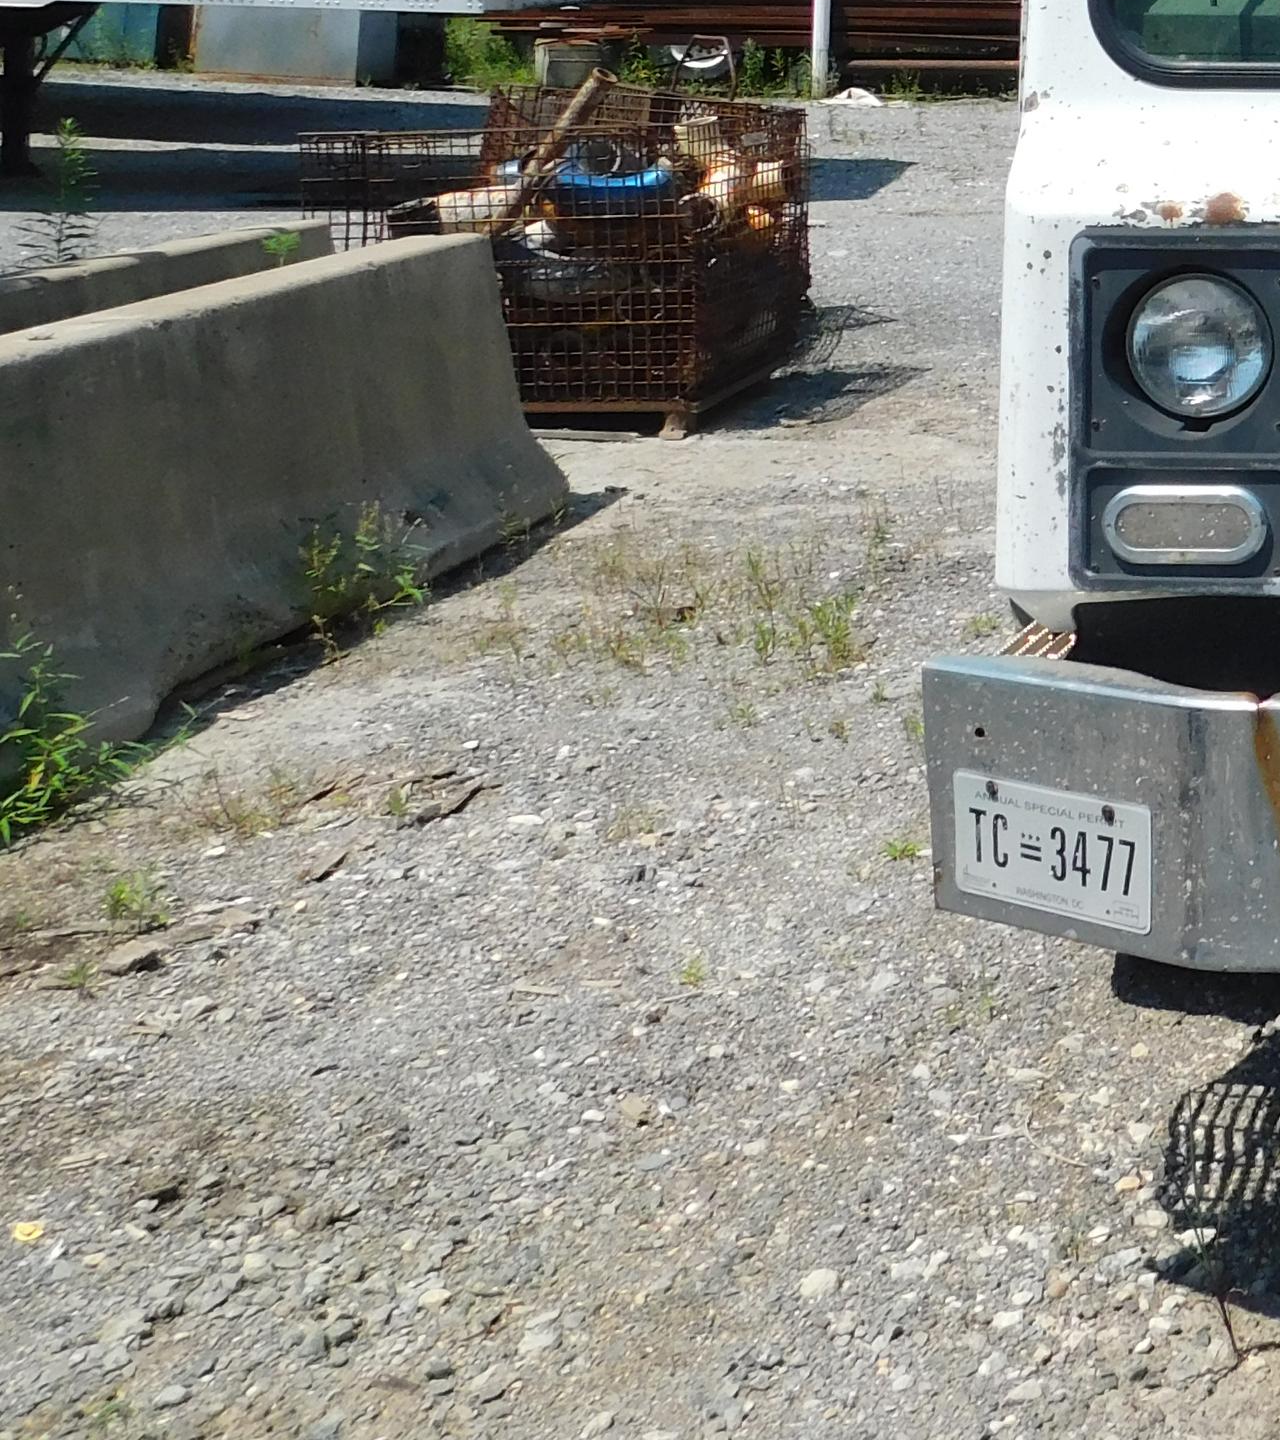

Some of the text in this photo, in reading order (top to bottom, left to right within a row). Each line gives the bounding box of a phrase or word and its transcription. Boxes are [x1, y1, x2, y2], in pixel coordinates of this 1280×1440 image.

[975, 791, 1021, 809] ANUAL
[1024, 801, 1075, 820] SPECIAL
[969, 807, 1136, 896] TC 3477
